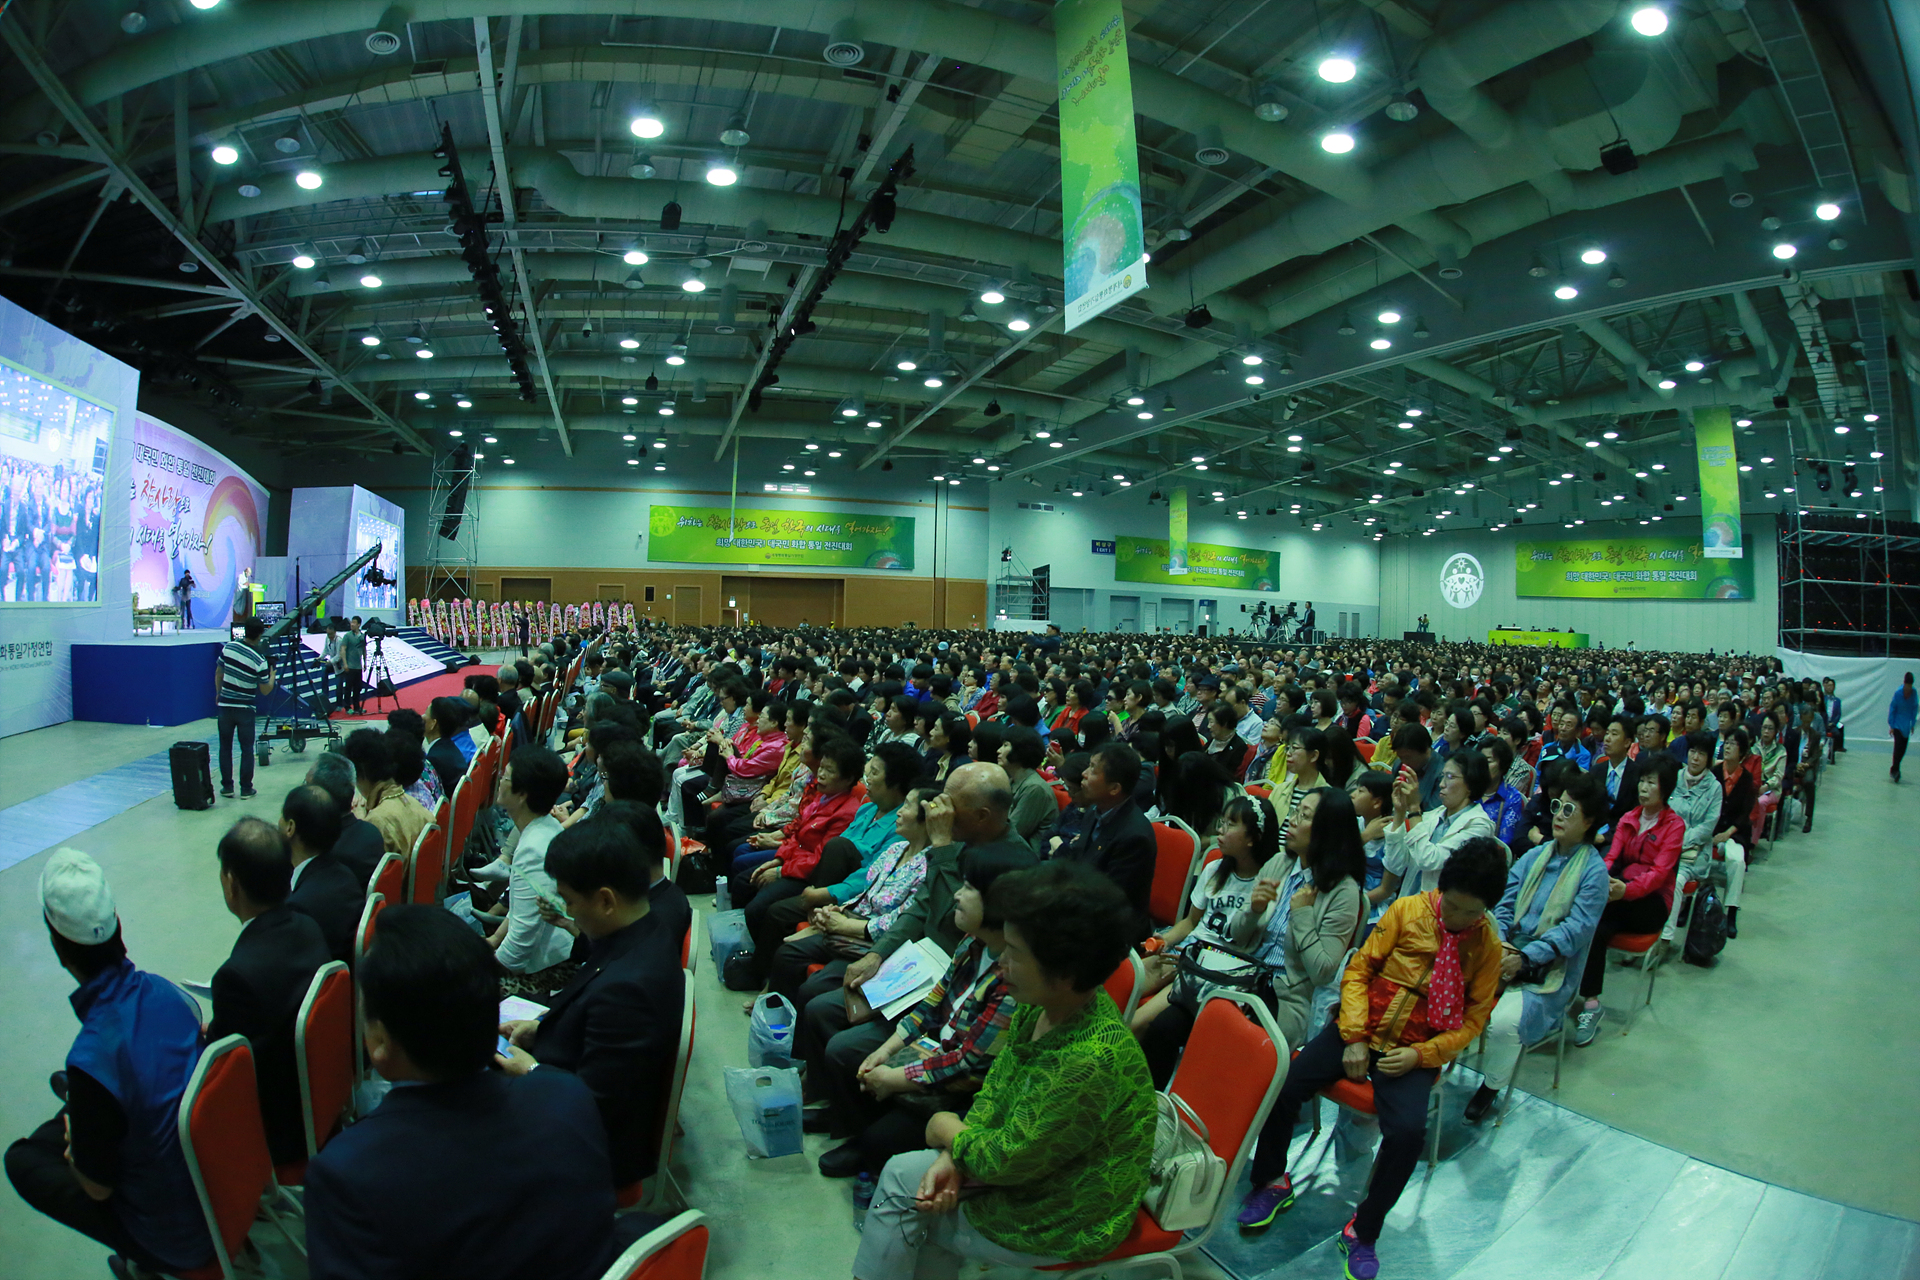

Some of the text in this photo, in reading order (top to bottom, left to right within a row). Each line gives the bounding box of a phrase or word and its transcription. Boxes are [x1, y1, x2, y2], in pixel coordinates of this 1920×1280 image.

[136, 443, 159, 467] 대국민
[160, 451, 175, 473] 화합
[176, 457, 191, 478] 통일
[191, 463, 217, 487] 전진대회
[716, 537, 731, 548] 희망
[767, 539, 790, 549] 대국민
[791, 540, 806, 549] 화합
[807, 541, 823, 550] 통일
[824, 541, 853, 551] 전진대회
[1566, 570, 1697, 582] 희망 대한민국! 대국민 화합 통일 전진대회
